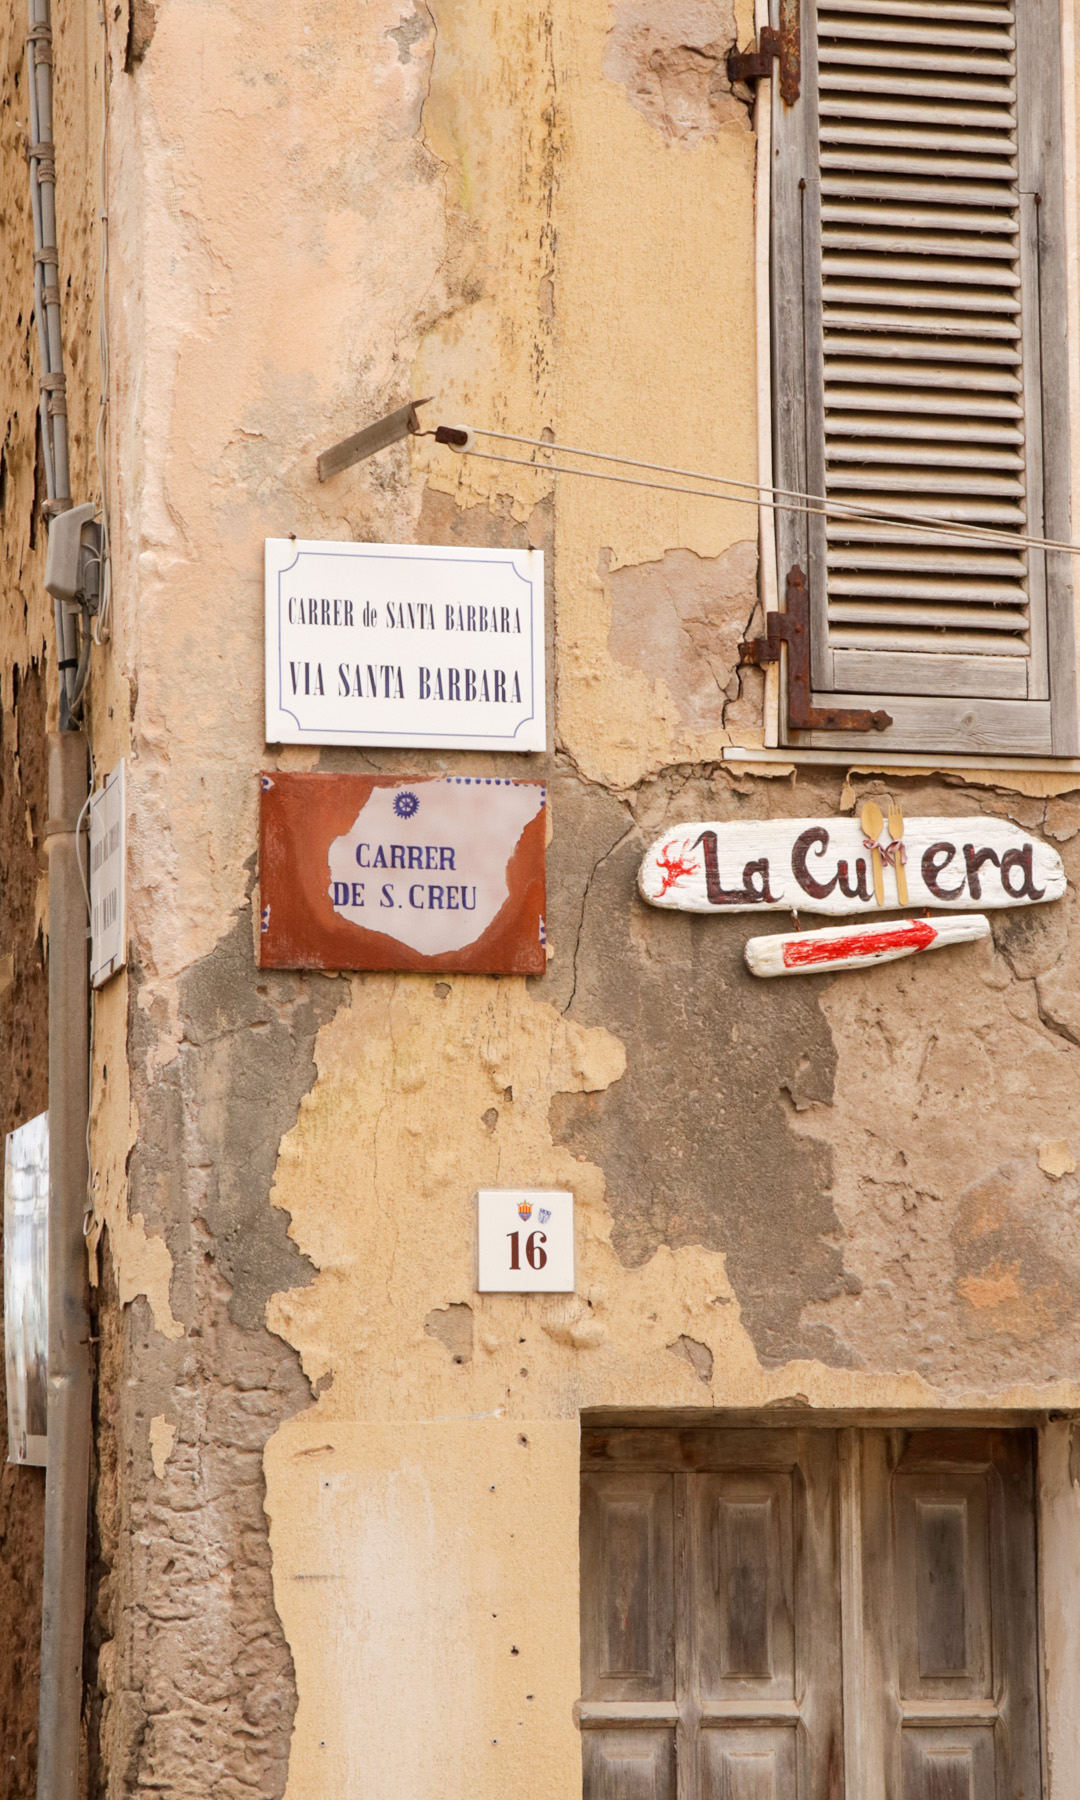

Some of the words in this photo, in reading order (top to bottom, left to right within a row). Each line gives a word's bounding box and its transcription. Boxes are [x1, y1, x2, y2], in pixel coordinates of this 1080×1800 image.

[288, 597, 354, 627] CARRER
[362, 600, 378, 628] de
[386, 600, 435, 630] SANTA
[445, 601, 522, 634] BÀRBARA
[289, 661, 325, 696] VIA
[338, 662, 405, 699] SANTA
[418, 666, 522, 703] BARBARA
[355, 843, 456, 871] CARRER
[690, 829, 785, 905] La
[333, 882, 365, 907] DE
[408, 884, 477, 910] CREU
[506, 1230, 548, 1270] 16
